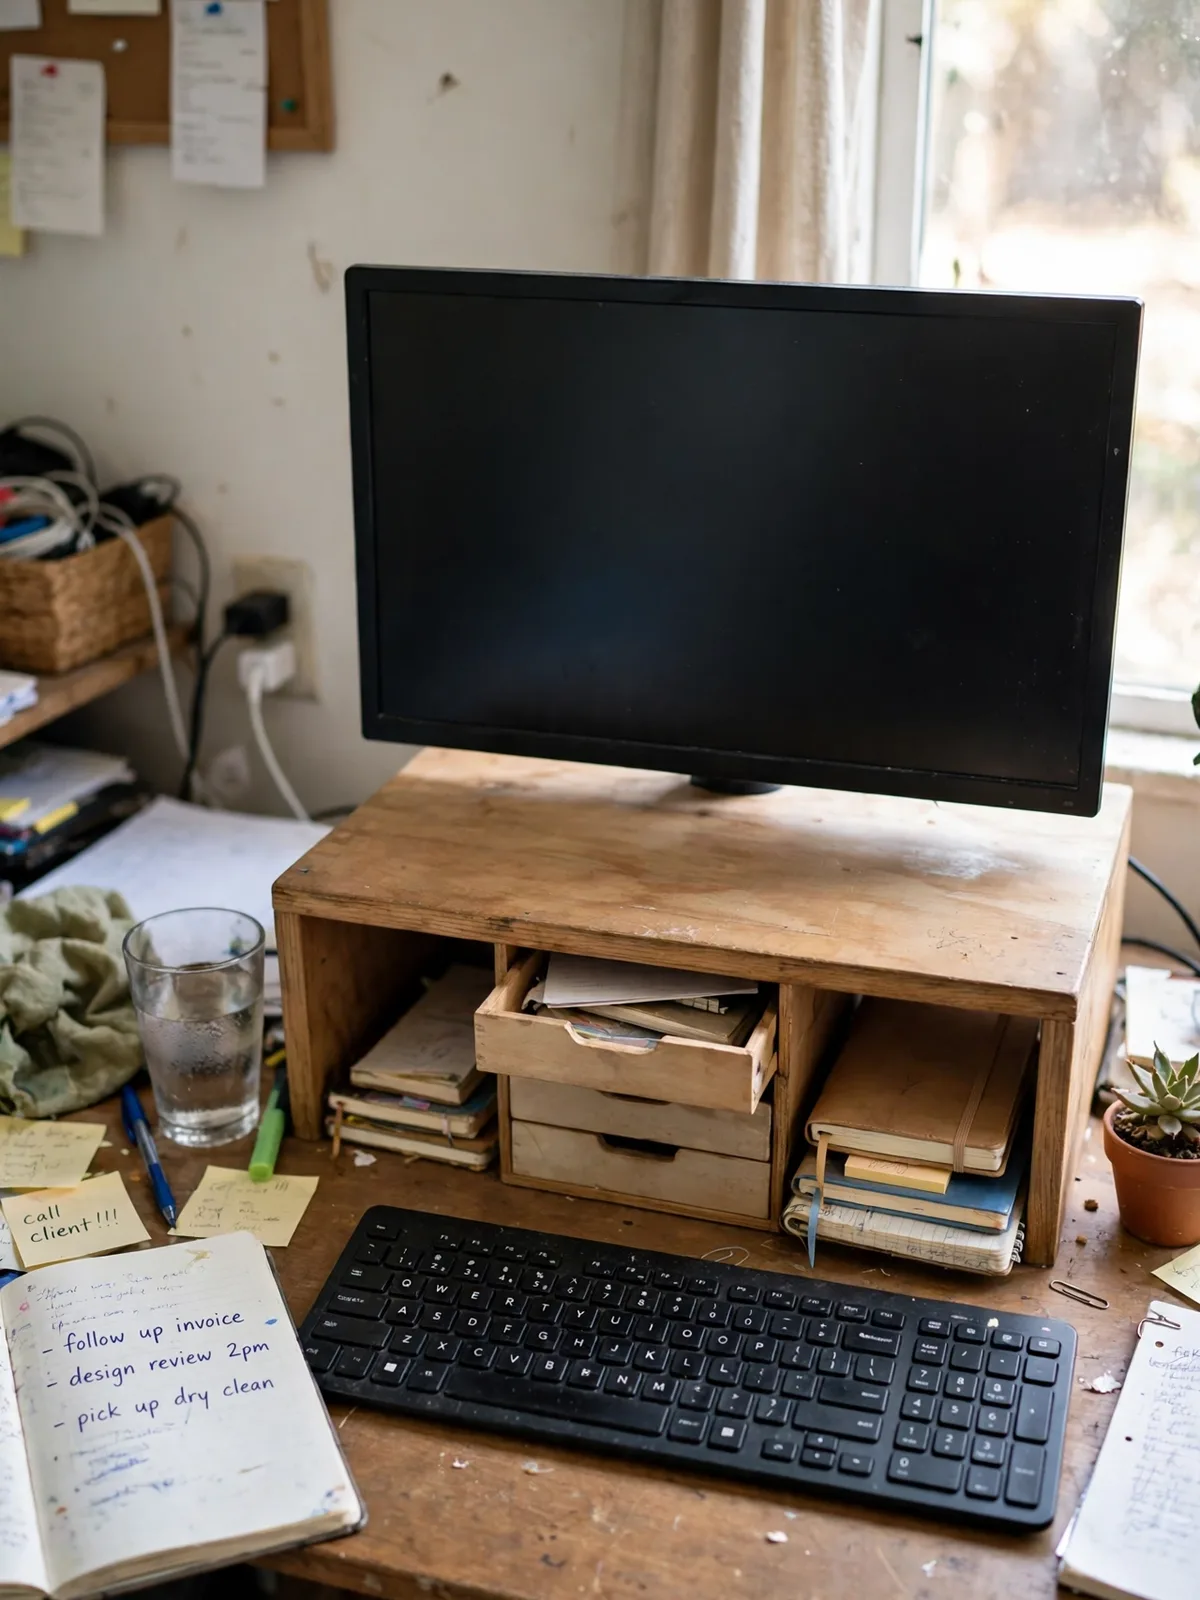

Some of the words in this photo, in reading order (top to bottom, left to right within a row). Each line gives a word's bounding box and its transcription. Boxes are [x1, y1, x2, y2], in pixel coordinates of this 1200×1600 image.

[23, 1204, 60, 1225] call
[30, 1208, 118, 1243] client!!!
[63, 1330, 125, 1354] follow
[139, 1326, 163, 1344] up
[175, 1312, 245, 1333] invoice
[401, 1278, 412, 1288] Q
[436, 1284, 449, 1293] W
[470, 1291, 480, 1300] E
[505, 1297, 515, 1307] R
[542, 1303, 550, 1312] T
[577, 1309, 585, 1318] Y
[610, 1315, 621, 1325] U
[755, 1341, 764, 1350] P
[397, 1306, 407, 1315] A
[432, 1311, 442, 1321] S
[467, 1317, 478, 1326] D
[503, 1324, 513, 1333] F
[538, 1331, 548, 1340] G
[573, 1338, 585, 1347] H
[610, 1344, 619, 1352] J
[645, 1350, 656, 1361] K
[683, 1358, 691, 1367] L
[719, 1363, 728, 1373] L
[69, 1364, 135, 1387] design
[149, 1350, 212, 1371] review
[226, 1342, 270, 1362] 2pm
[402, 1334, 413, 1344] Z
[437, 1341, 448, 1351] X
[473, 1347, 484, 1357] C
[510, 1354, 520, 1363] V
[544, 1360, 555, 1370] B
[616, 1374, 629, 1385] N
[652, 1381, 666, 1391] M
[920, 1369, 928, 1378] 7
[77, 1405, 121, 1433] pick
[135, 1399, 159, 1419] up
[174, 1387, 209, 1410] dry
[222, 1378, 274, 1397] clean
[951, 1405, 959, 1414] 5
[945, 1434, 954, 1443] 2
